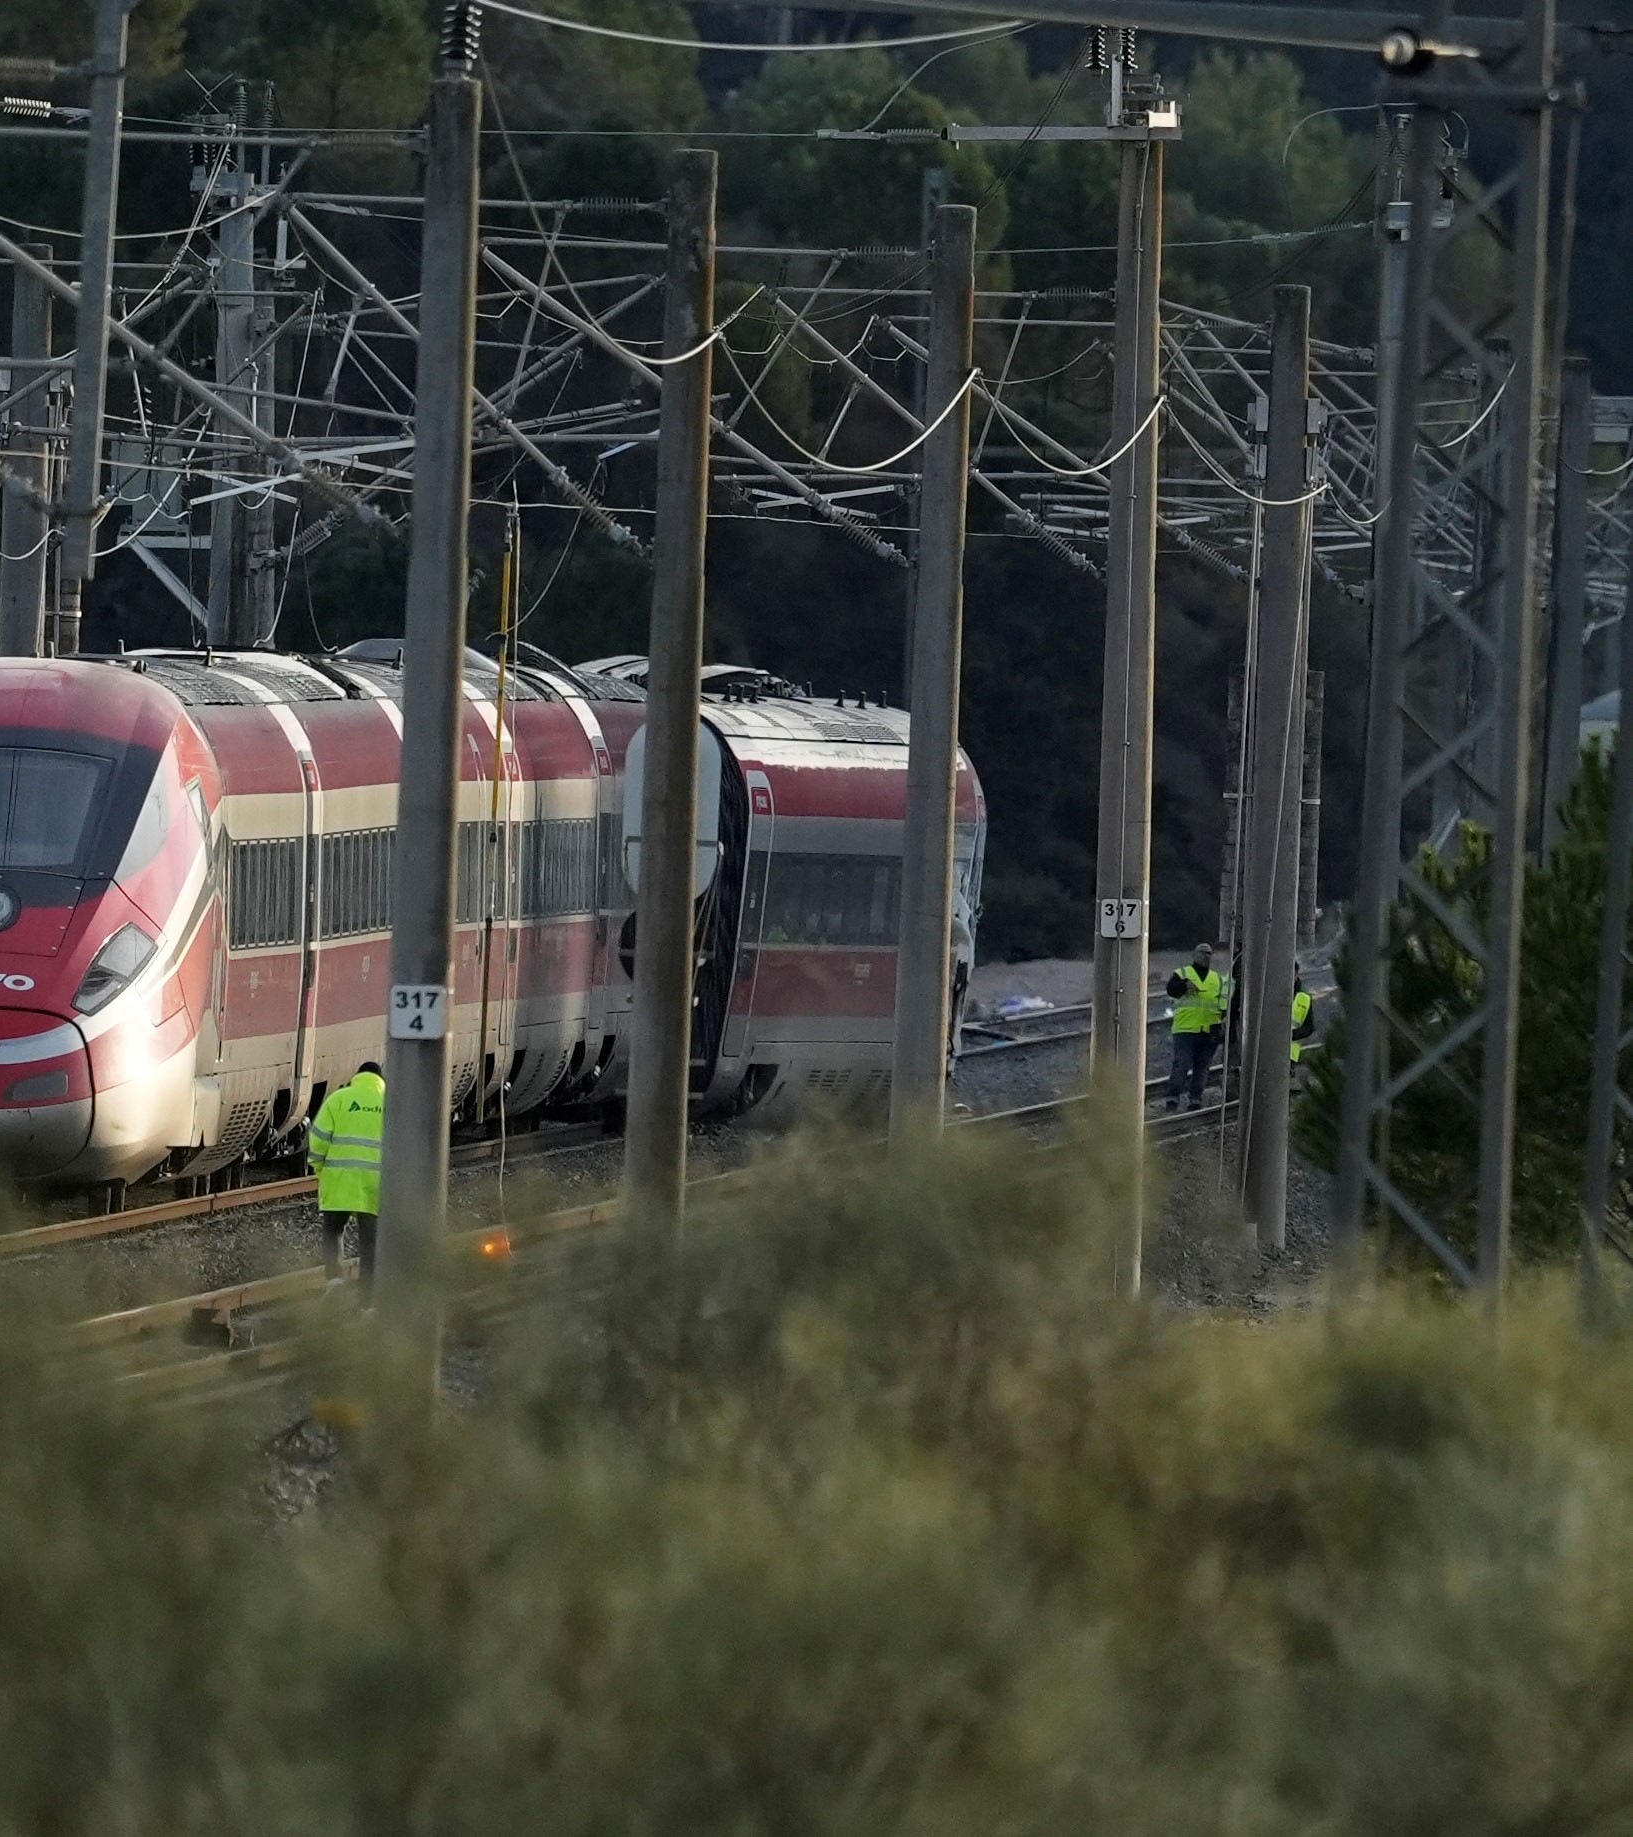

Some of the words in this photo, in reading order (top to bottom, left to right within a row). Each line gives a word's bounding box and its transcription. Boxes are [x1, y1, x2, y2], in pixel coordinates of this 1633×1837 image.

[1104, 903, 1137, 917] 317
[1114, 920, 1126, 934] 6
[395, 990, 439, 1009] 317
[409, 1014, 424, 1032] 4
